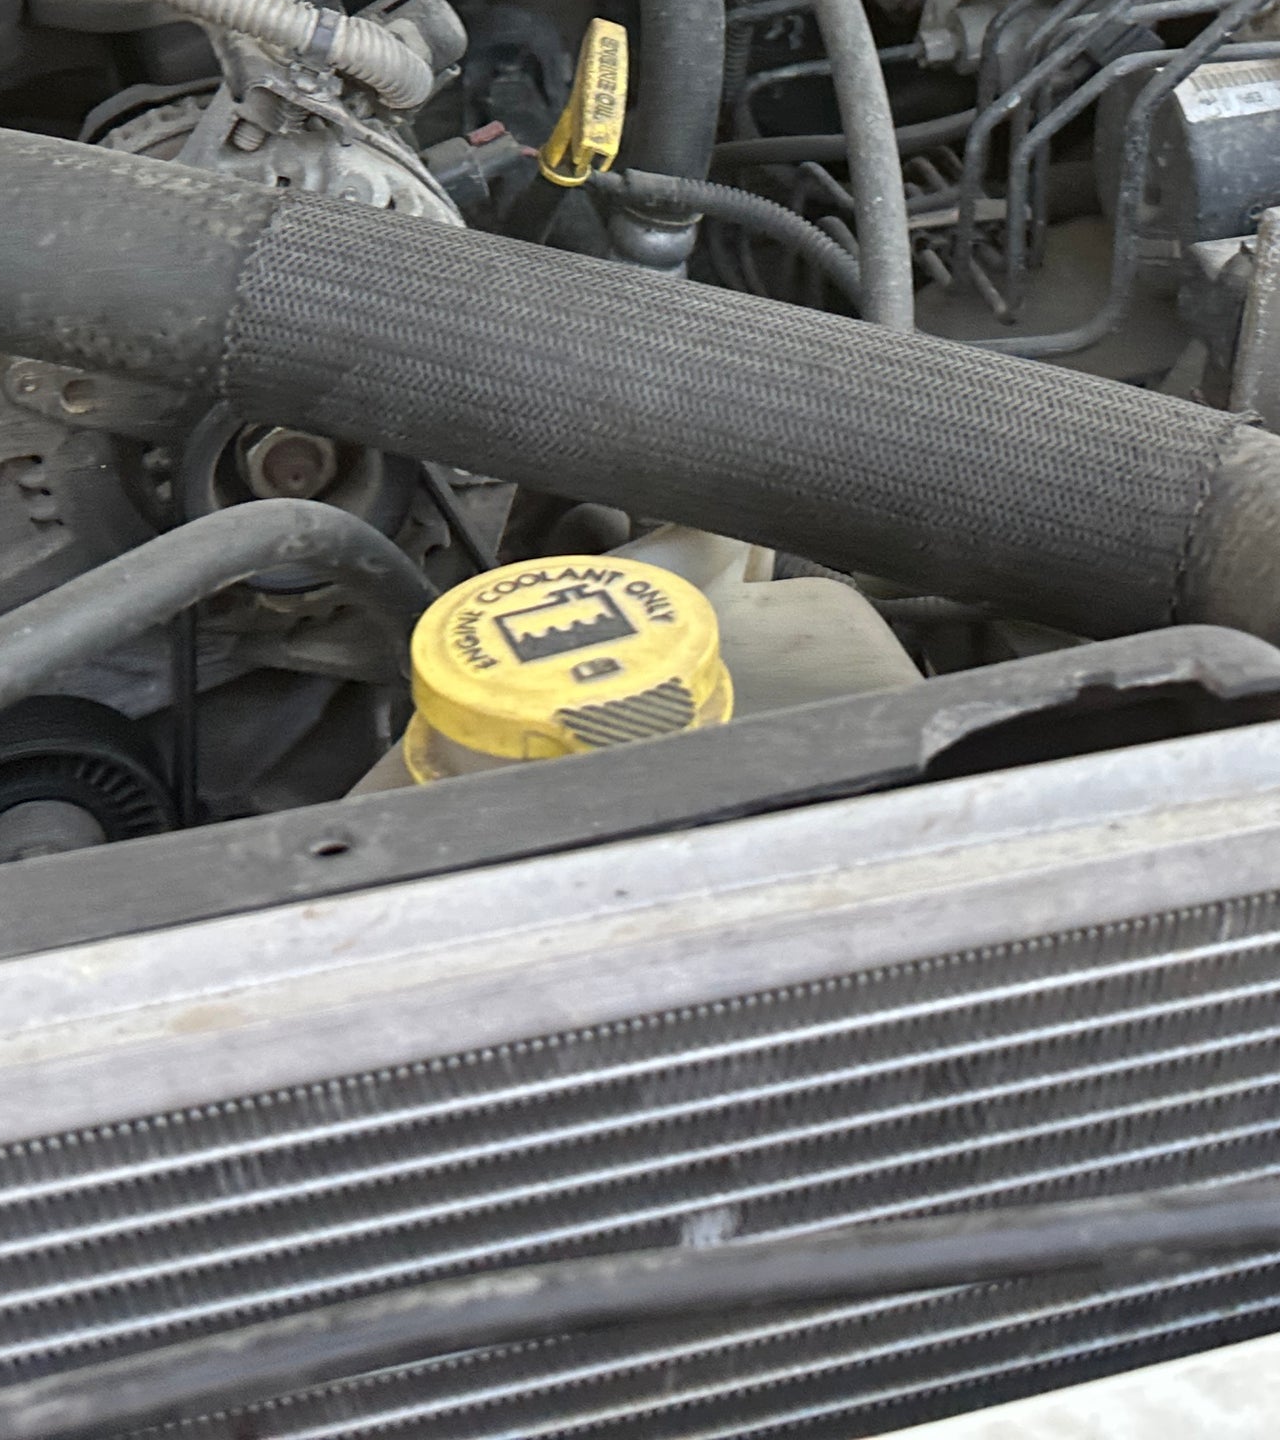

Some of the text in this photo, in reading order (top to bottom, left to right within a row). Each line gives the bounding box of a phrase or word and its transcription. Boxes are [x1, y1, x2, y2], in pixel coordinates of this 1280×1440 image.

[594, 37, 619, 122] ENGINE OIL
[451, 567, 675, 670] ENGINE COOLANT ONLY
